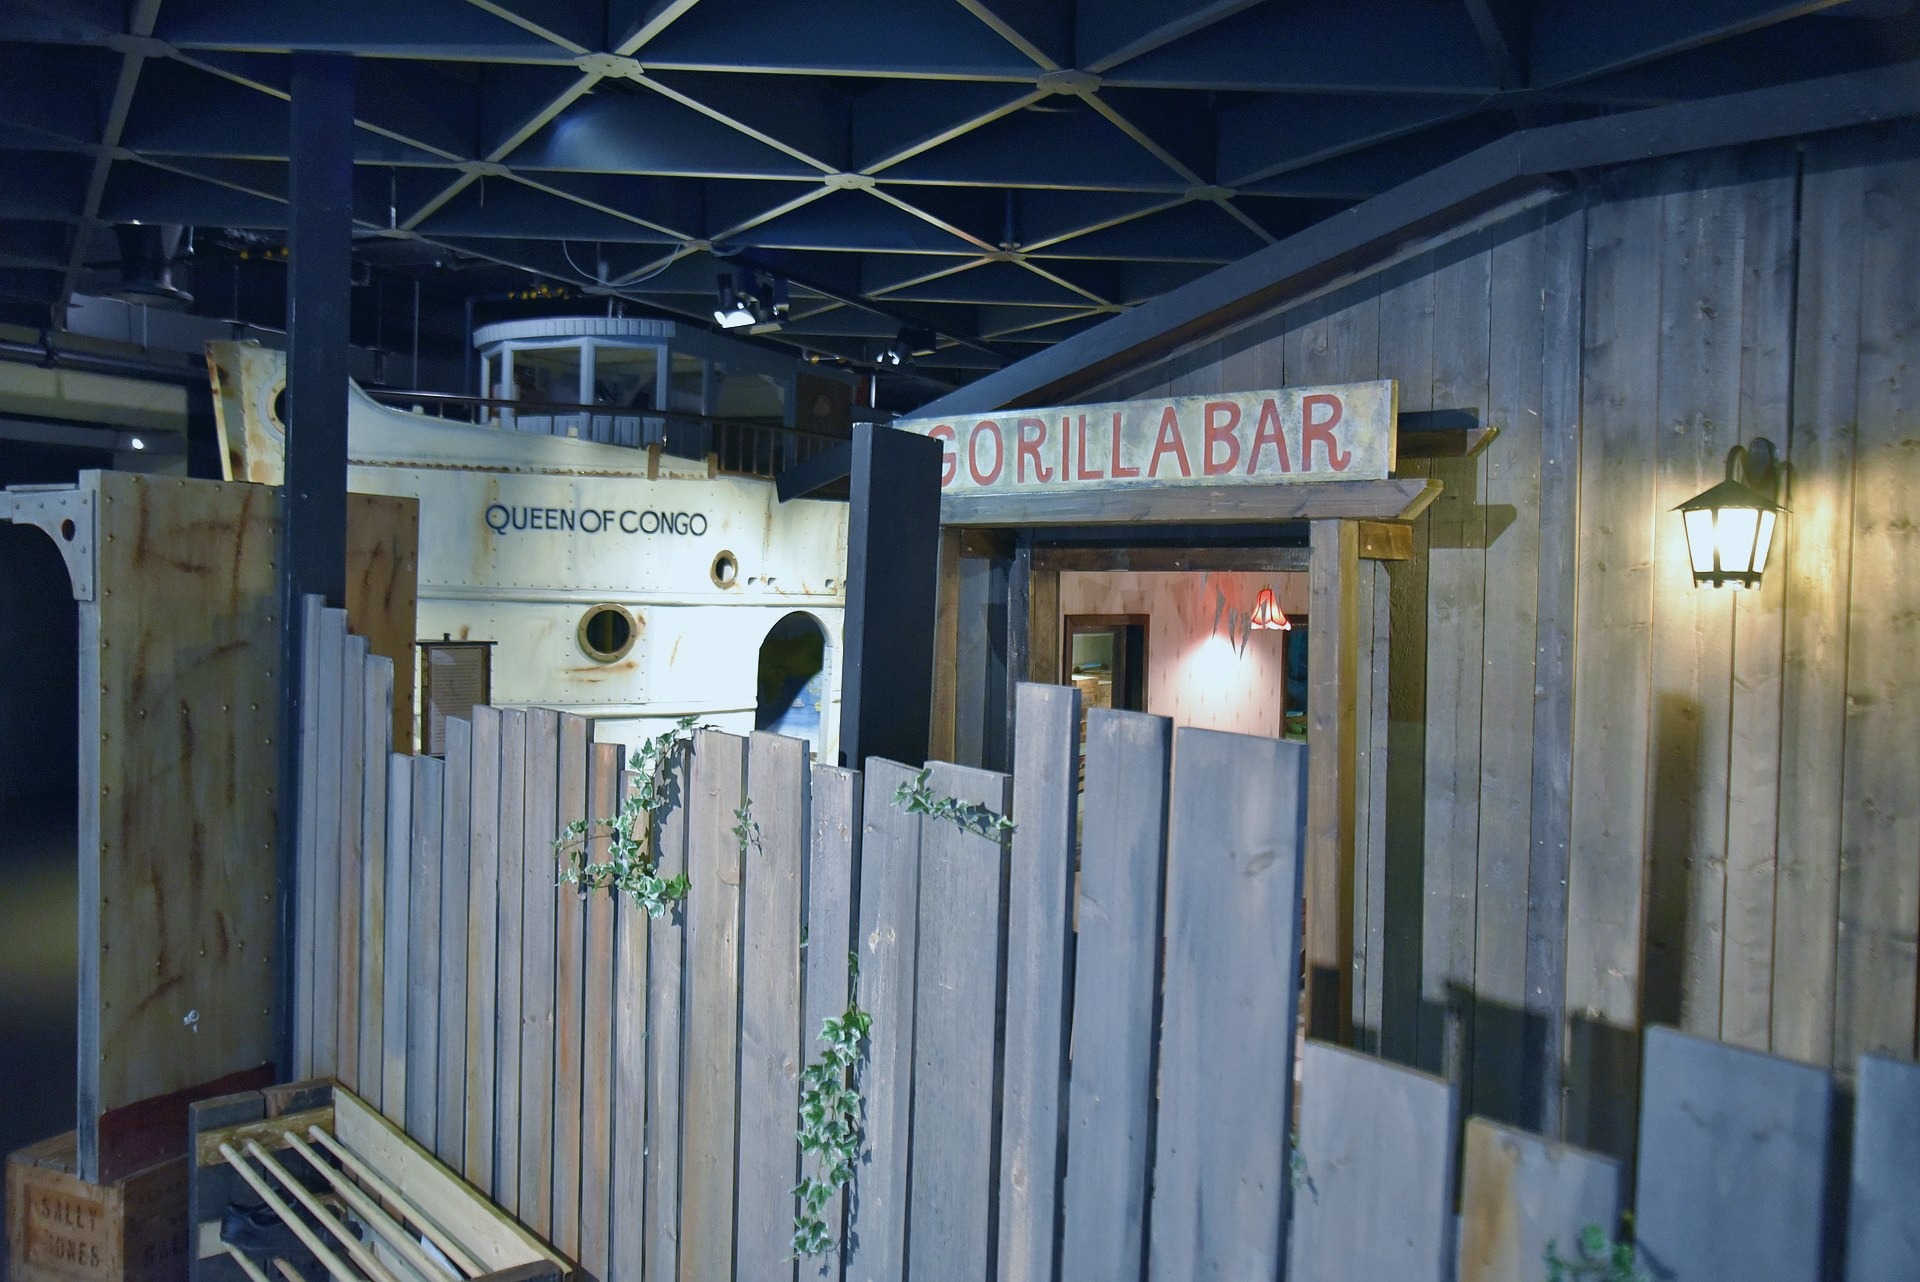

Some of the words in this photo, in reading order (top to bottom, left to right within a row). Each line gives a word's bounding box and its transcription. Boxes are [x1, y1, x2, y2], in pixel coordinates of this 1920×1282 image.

[927, 405, 1192, 488] GORILLA
[1203, 393, 1352, 476] BAR
[485, 504, 575, 535] QUEEN
[579, 509, 616, 534] OF
[619, 510, 708, 537] CONGO
[41, 1196, 98, 1232] SALLY
